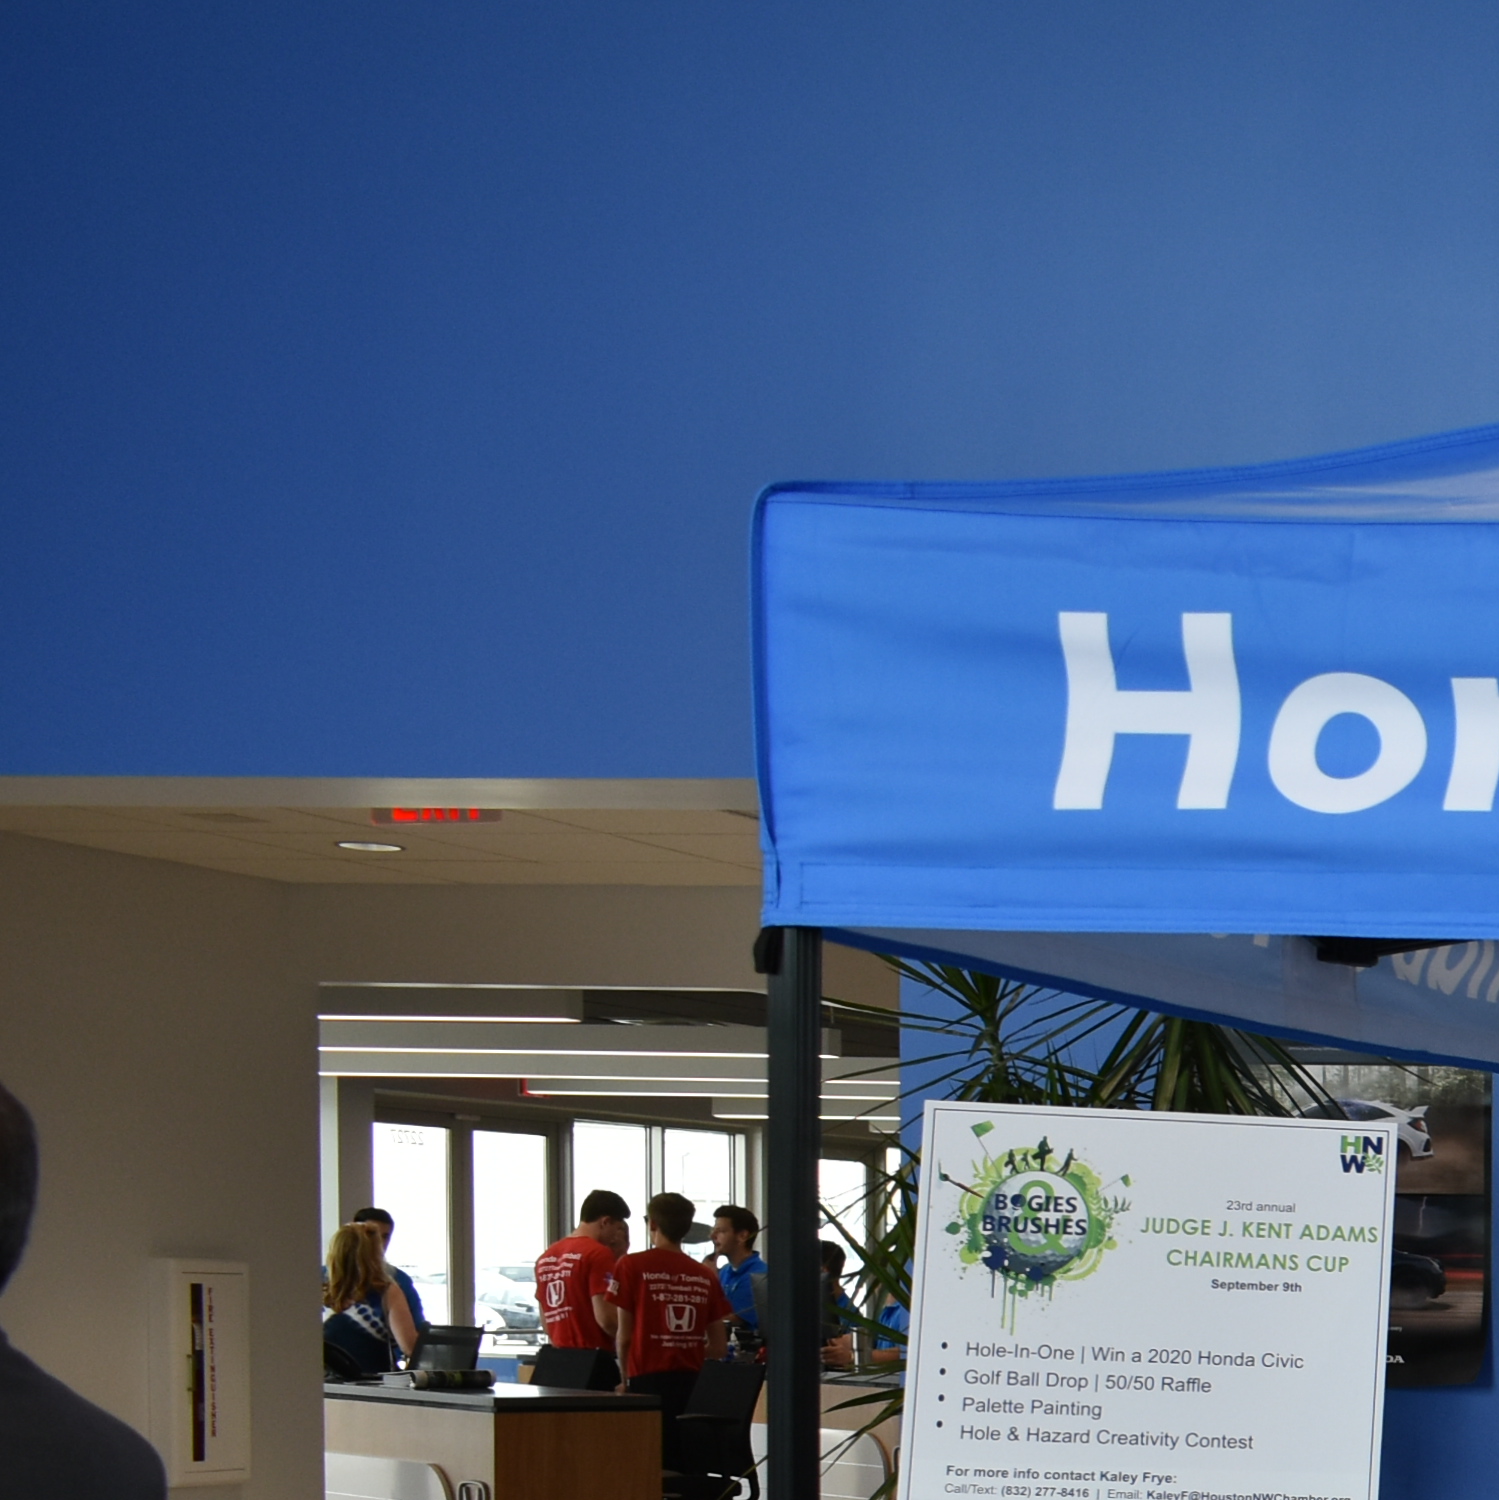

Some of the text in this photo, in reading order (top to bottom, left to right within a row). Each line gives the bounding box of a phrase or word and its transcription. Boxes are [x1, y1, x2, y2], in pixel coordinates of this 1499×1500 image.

[1226, 1200, 1297, 1214] 23rd annual
[982, 1214, 1088, 1236] BRUSHES
[1140, 1217, 1379, 1244] JUDGE J. KENT ADAMS
[1166, 1249, 1350, 1273] CHAIRMANS CUP
[1210, 1278, 1303, 1293] September 9th
[965, 1341, 1305, 1369] Hole-In-One Win a 2020 Honda Civic
[963, 1368, 1212, 1393] Golf Ball Drop 50/50 Raffle
[961, 1396, 1103, 1421] Palette Painting
[959, 1424, 1255, 1451] Hole & Hazard Creativity Contest
[945, 1465, 1178, 1485] For more info contact Kaley Frye:
[944, 1482, 998, 1495] Call/Text:
[1000, 1485, 1032, 1498] (832)
[1034, 1486, 1090, 1498] 277-8416
[1106, 1488, 1144, 1500] Email:
